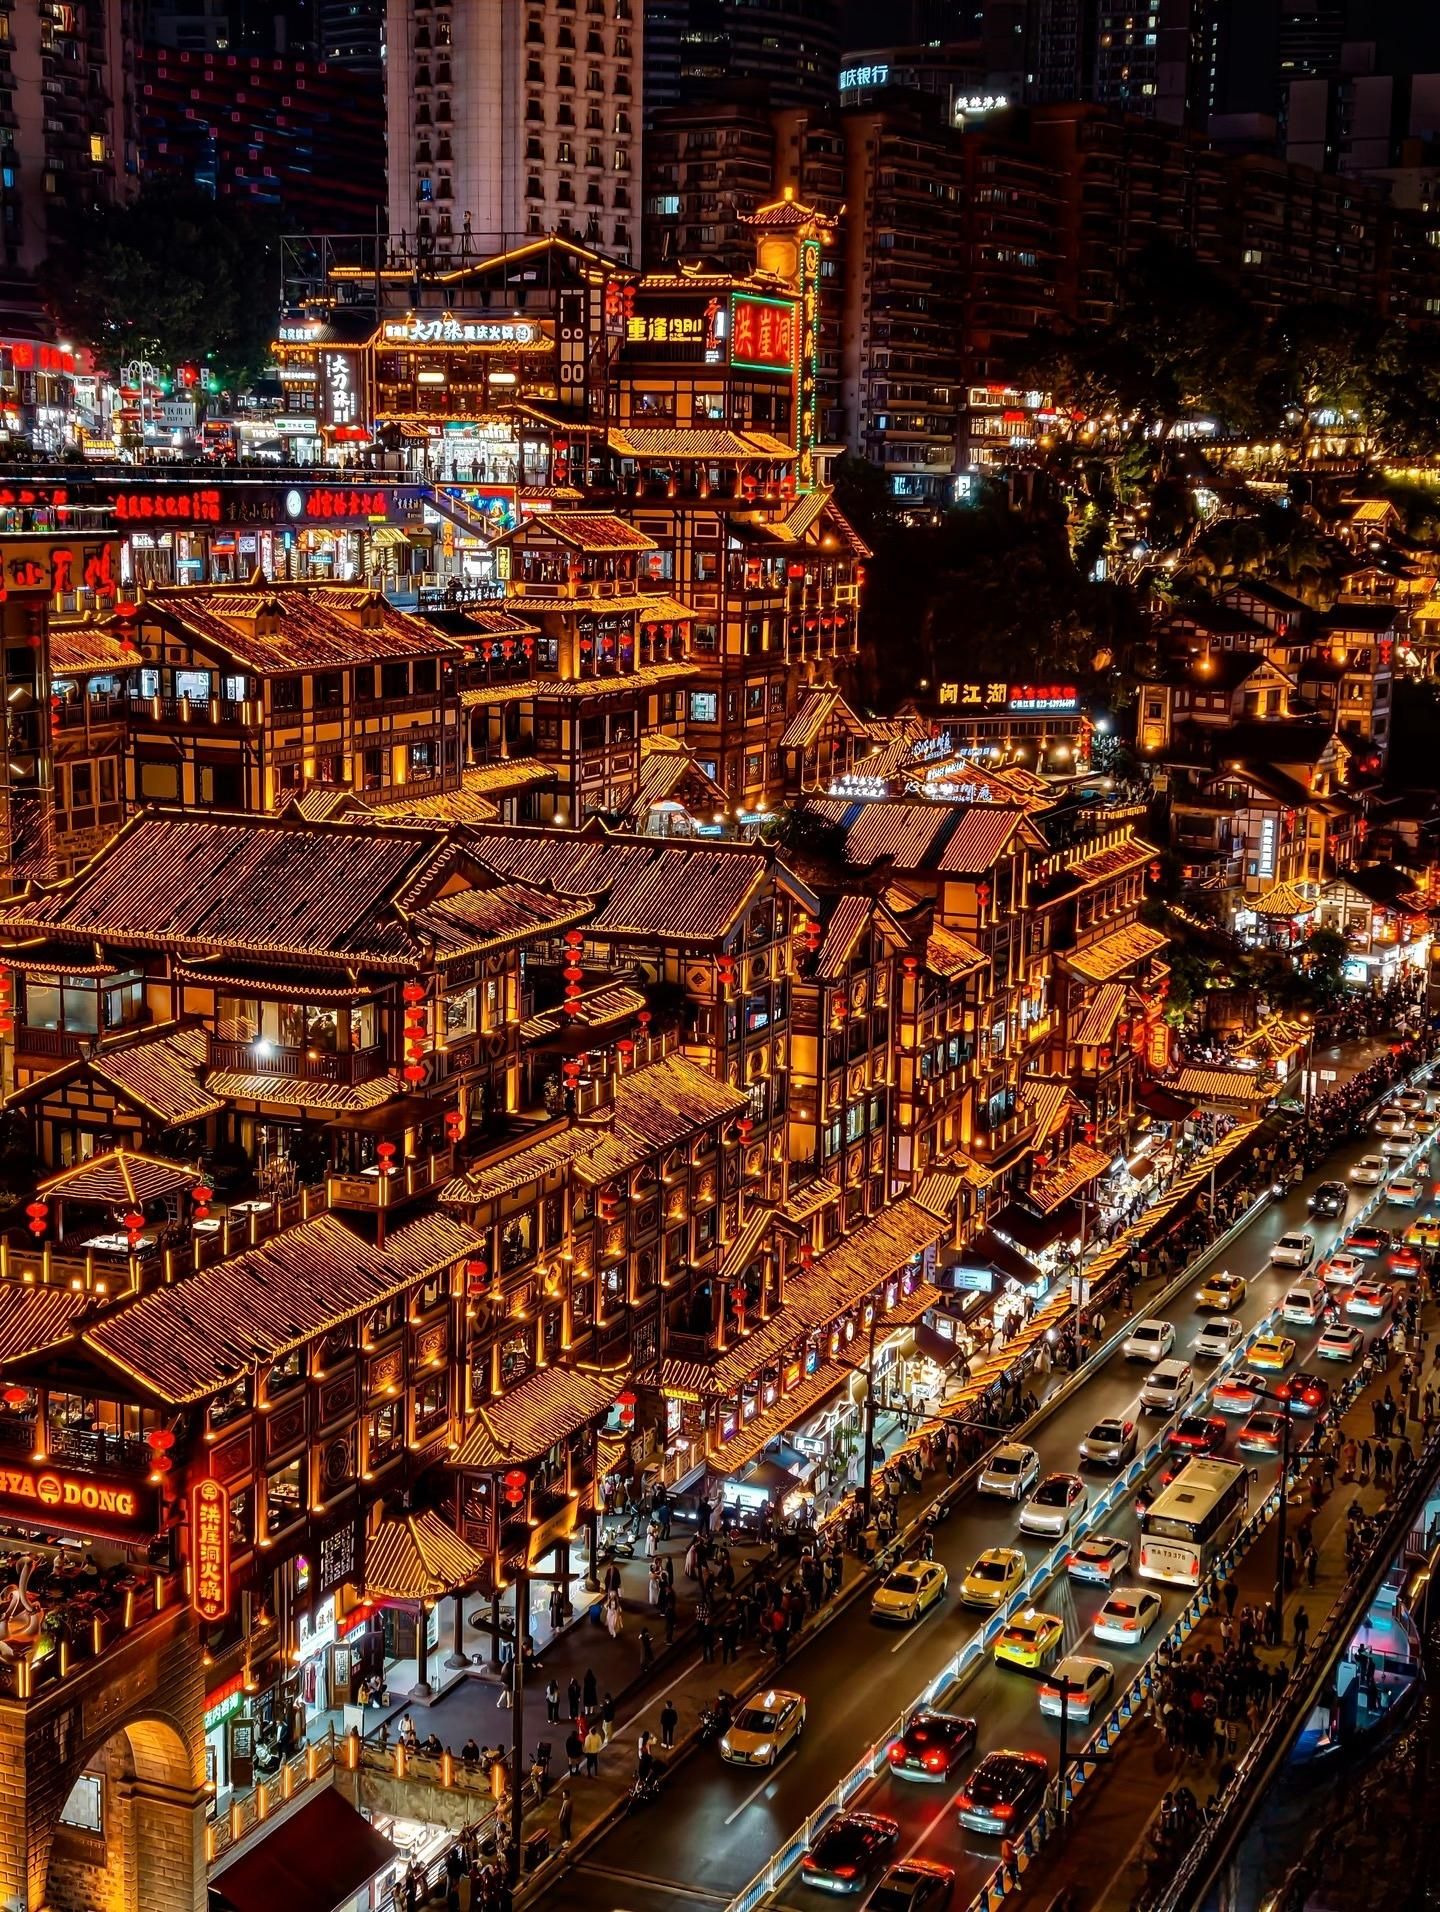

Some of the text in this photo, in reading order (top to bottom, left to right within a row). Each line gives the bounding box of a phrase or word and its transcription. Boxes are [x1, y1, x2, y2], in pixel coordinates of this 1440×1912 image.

[735, 307, 792, 358] 洪崖洞
[939, 683, 1008, 704] 闹江湖
[64, 1482, 134, 1515] DONG
[199, 1503, 221, 1601] 洪崖洞火锅
